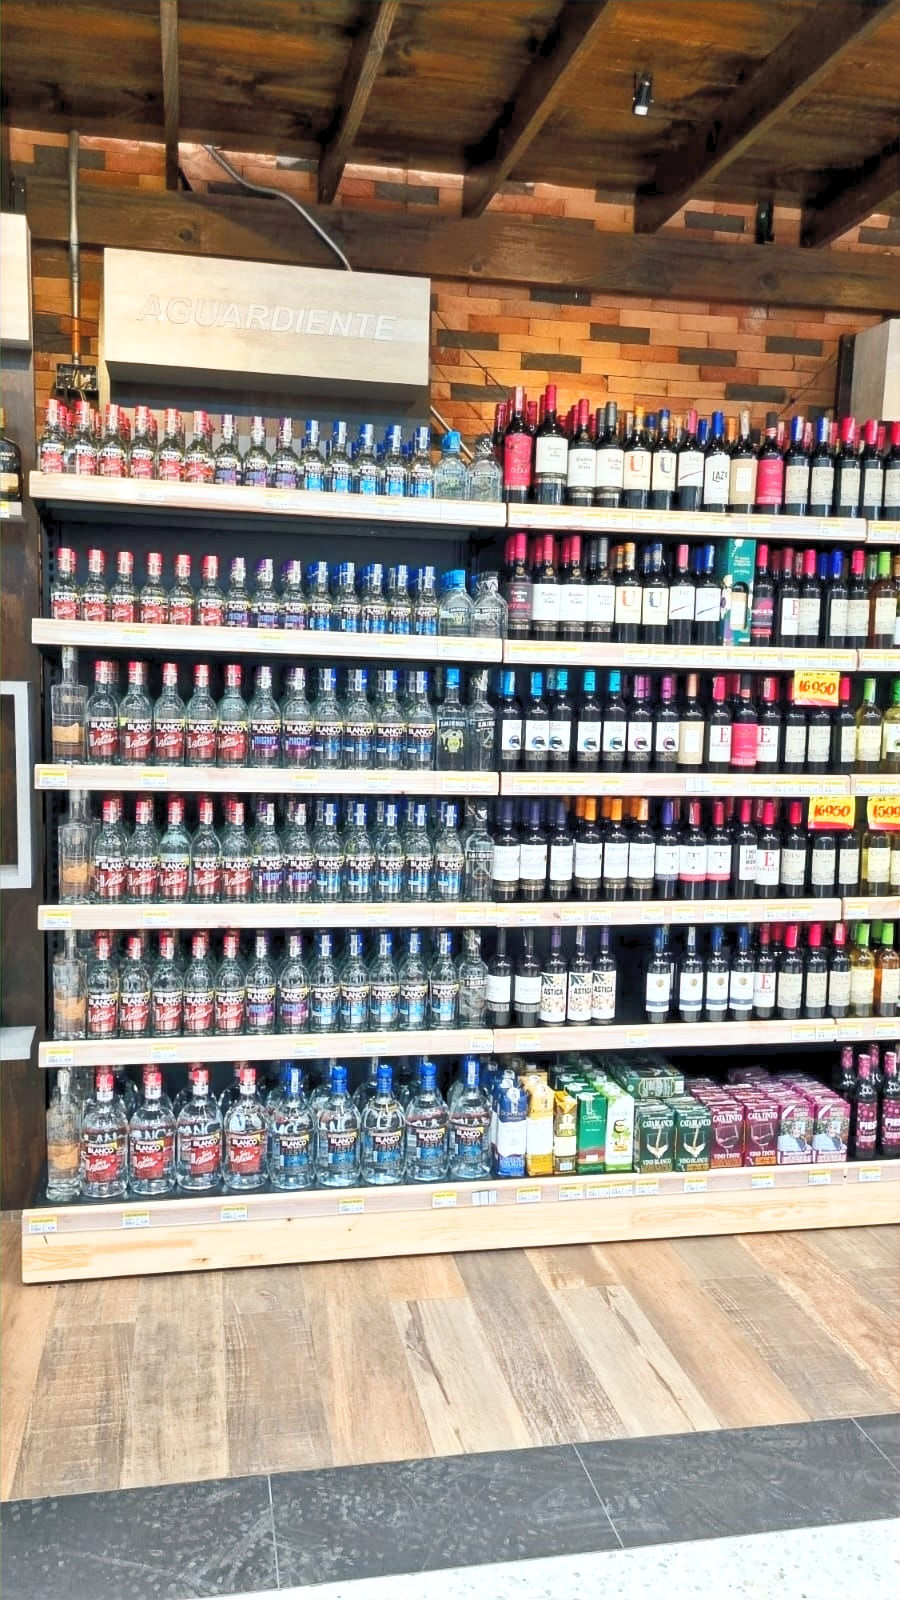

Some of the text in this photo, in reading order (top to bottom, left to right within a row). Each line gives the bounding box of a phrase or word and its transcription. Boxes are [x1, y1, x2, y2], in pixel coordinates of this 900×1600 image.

[136, 294, 397, 342] AGUARDIENTE
[544, 988, 564, 996] ASTICA
[418, 1133, 443, 1142] BLANCO
[457, 1130, 481, 1139] BLANCO
[194, 1138, 218, 1147] BLANCO
[232, 1138, 257, 1146] BLANCO
[282, 1140, 307, 1149] BLANCO
[331, 1137, 356, 1145] BLANCO
[376, 1136, 400, 1145] BLANCO
[88, 1147, 114, 1155] BLANCO
[136, 1143, 160, 1152] BLANCO
